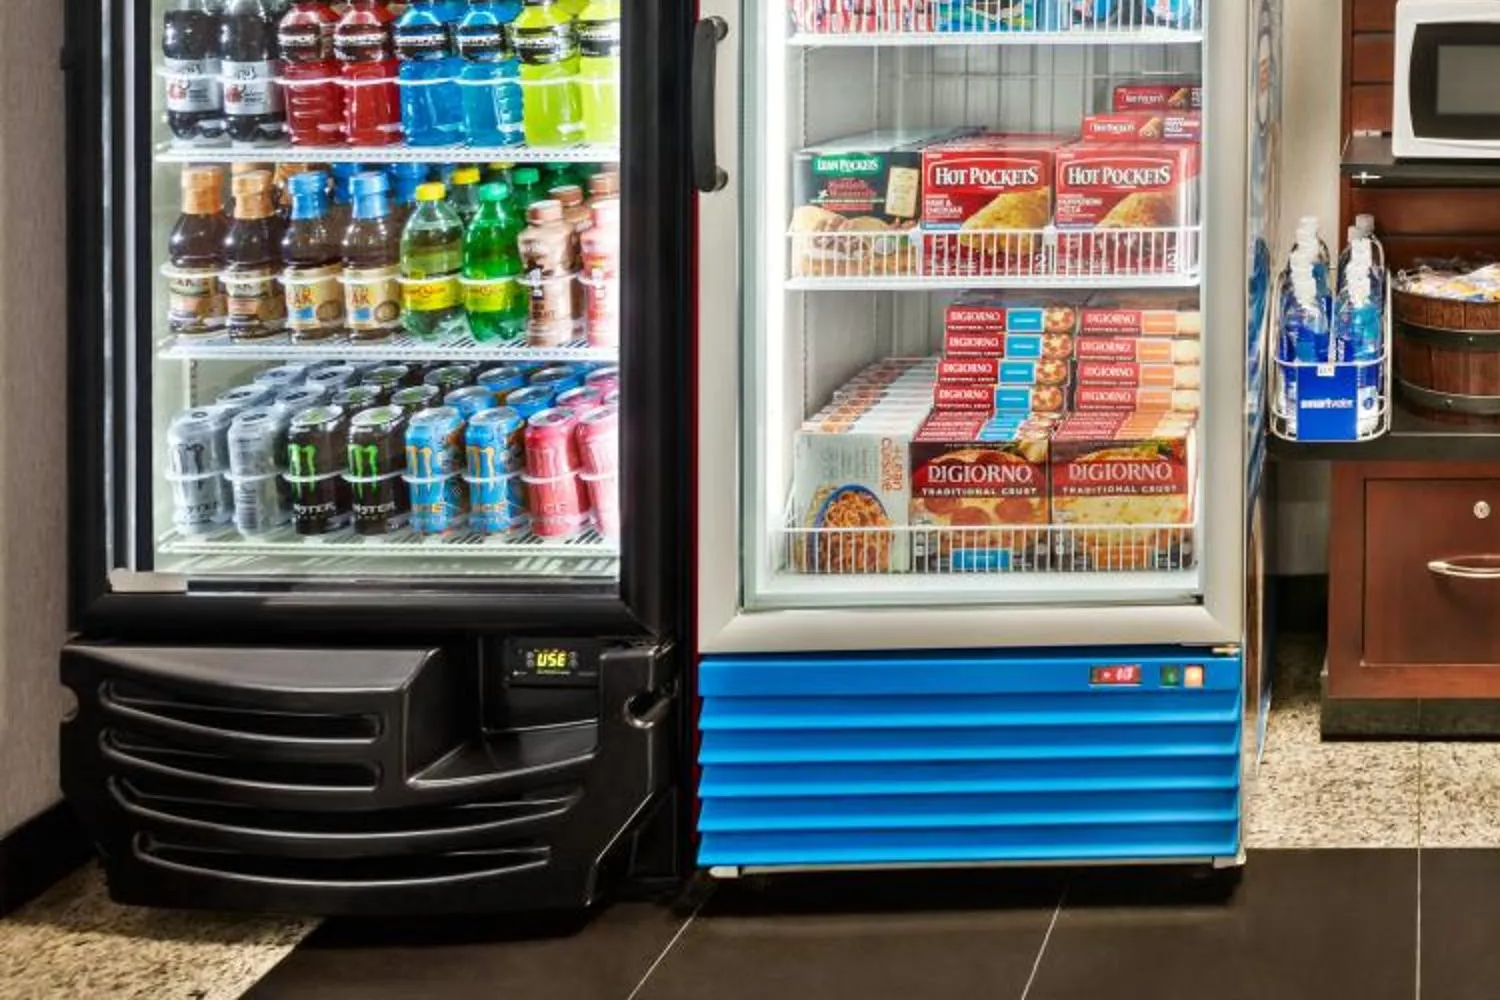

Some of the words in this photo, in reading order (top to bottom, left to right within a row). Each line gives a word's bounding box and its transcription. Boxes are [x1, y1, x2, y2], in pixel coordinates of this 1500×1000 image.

[934, 166, 969, 186] HOT
[969, 166, 1040, 187] POCKETS
[1067, 166, 1101, 186] HOT
[1102, 165, 1172, 186] POCKETS
[927, 464, 1033, 483] DIGIORNO
[1068, 462, 1173, 482] DIGIORNO
[921, 487, 997, 496] TRADITIONAL
[1001, 487, 1037, 496] CRUST
[1062, 485, 1137, 495] TRADITIONAL
[1141, 484, 1177, 494] CRUST
[537, 652, 567, 668] USE
